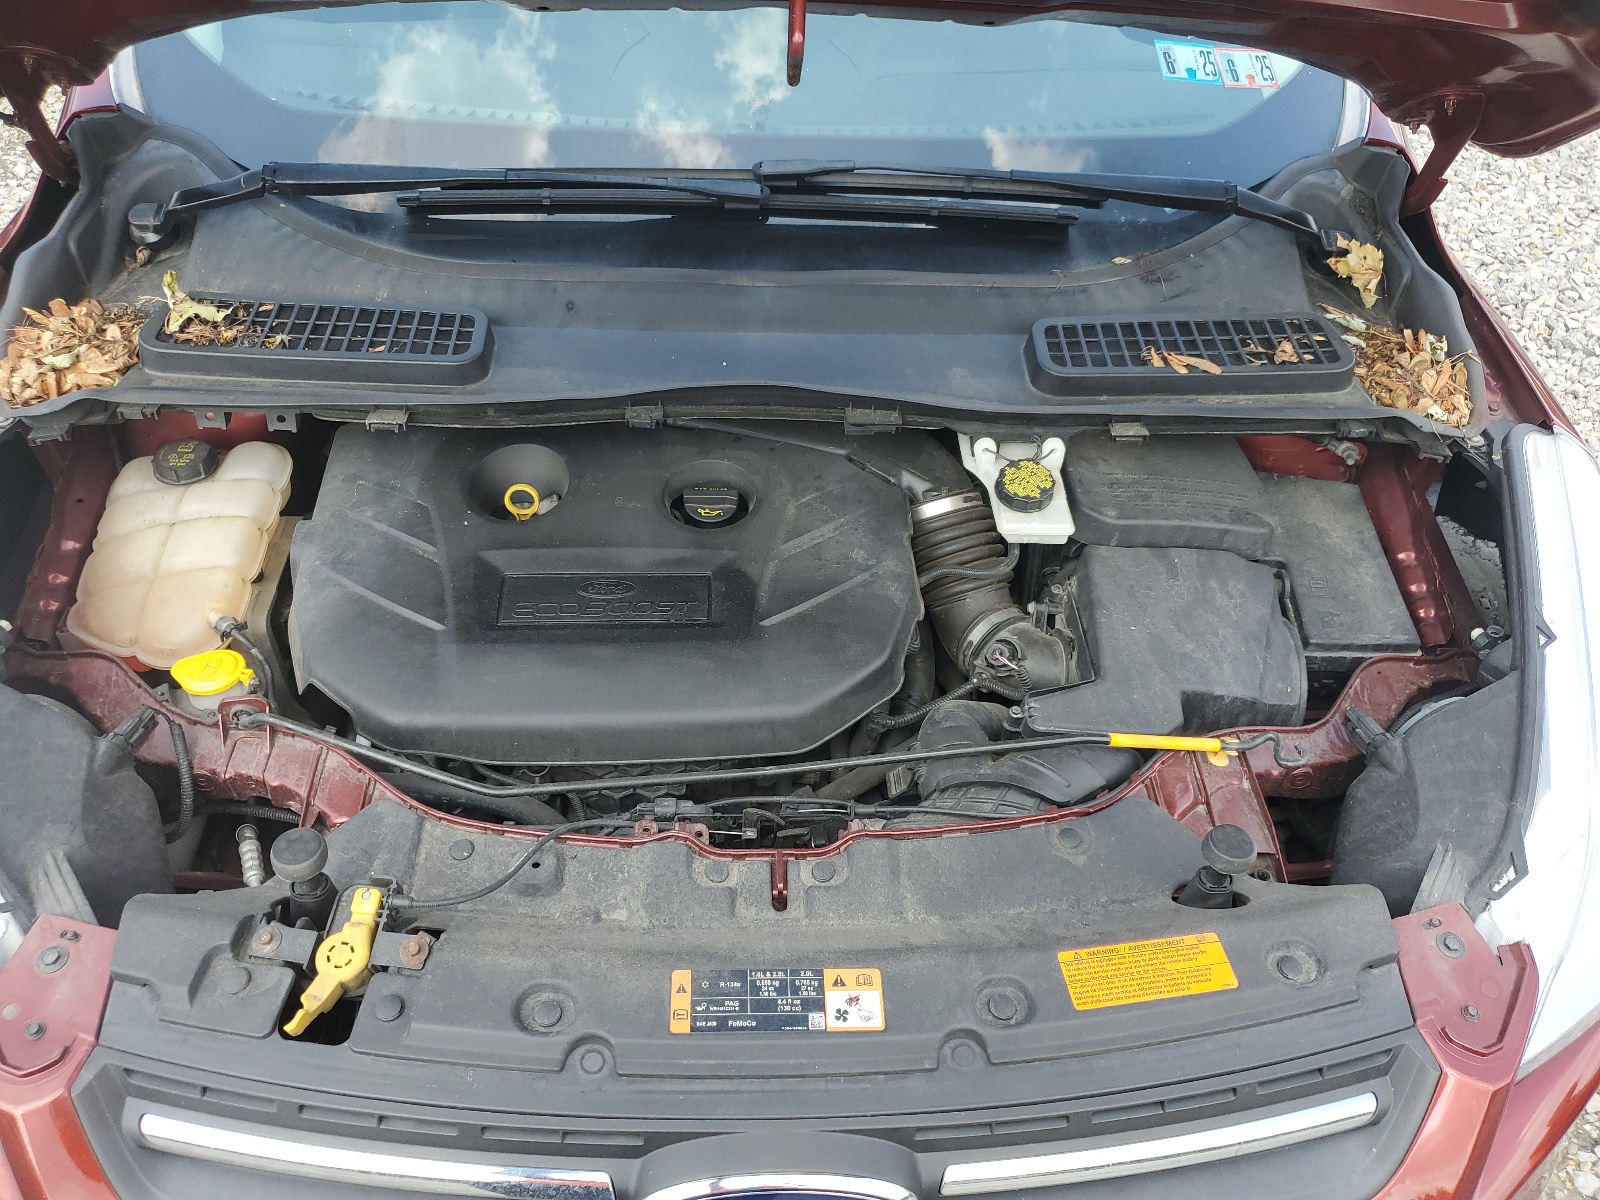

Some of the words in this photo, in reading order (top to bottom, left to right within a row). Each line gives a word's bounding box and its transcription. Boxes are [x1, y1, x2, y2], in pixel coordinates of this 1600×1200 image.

[1199, 50, 1217, 77] 25
[1227, 59, 1239, 82] 6
[1255, 55, 1274, 81] 25
[588, 583, 626, 594] Ford
[511, 602, 699, 618] ECOBOOST
[1085, 947, 1122, 957] WARNING:
[1127, 939, 1186, 952] AVERTISSEMENT
